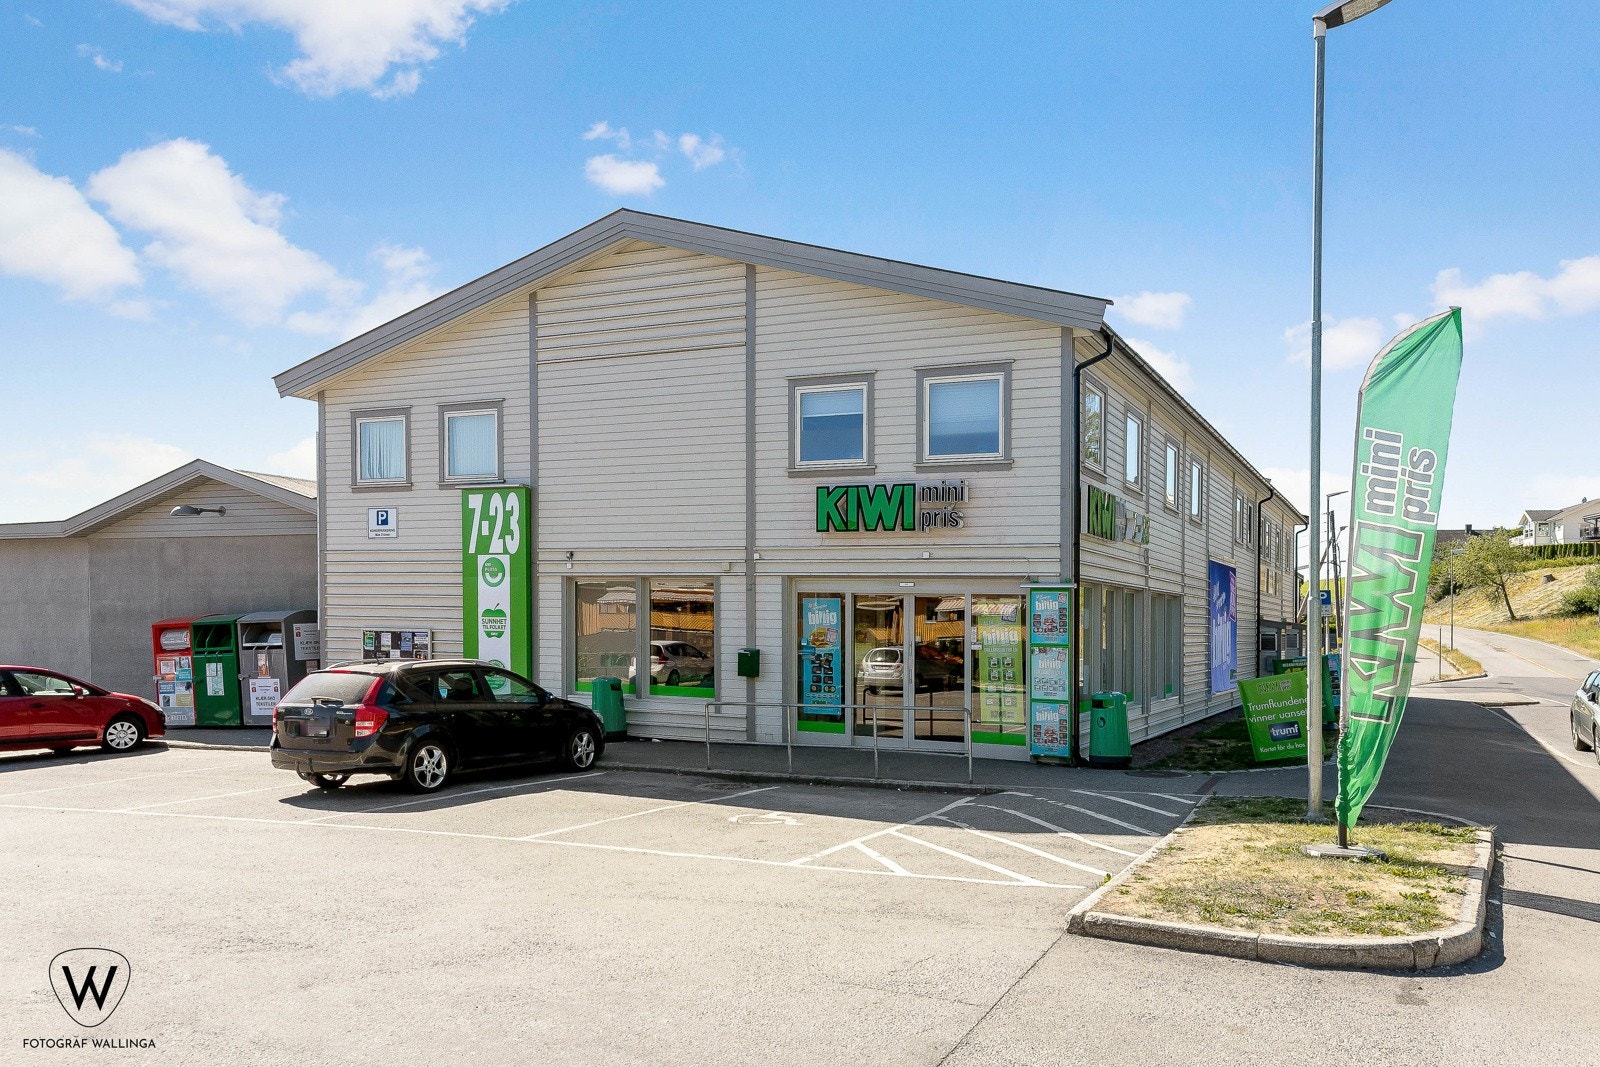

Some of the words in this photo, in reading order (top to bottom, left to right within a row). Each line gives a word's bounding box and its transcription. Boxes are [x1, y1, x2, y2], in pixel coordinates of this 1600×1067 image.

[1360, 427, 1403, 516] mini
[1400, 447, 1437, 526] pris
[816, 483, 916, 532] KIWI
[920, 480, 968, 503] mini
[378, 511, 387, 525] P
[468, 492, 520, 554] 7-23
[920, 506, 964, 533] pris
[1350, 518, 1425, 724] KIWI
[1249, 713, 1276, 723] vinner
[1271, 724, 1299, 736] trumf
